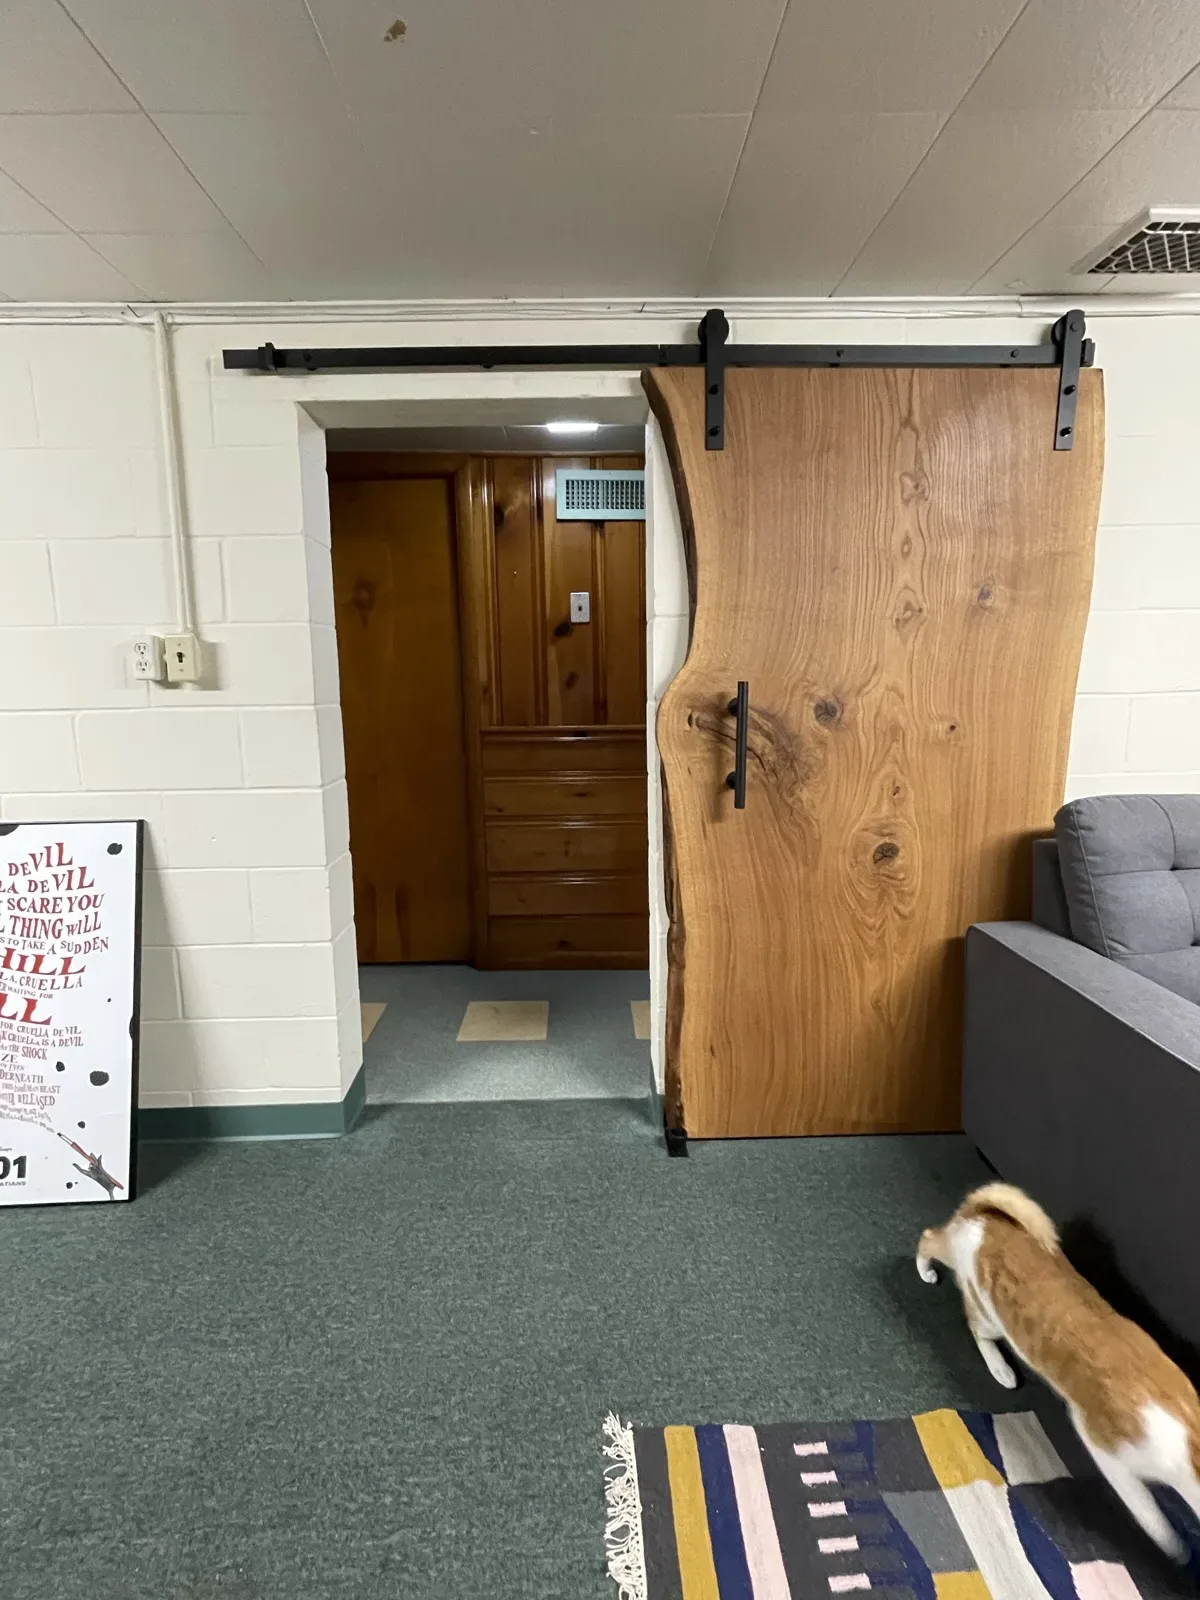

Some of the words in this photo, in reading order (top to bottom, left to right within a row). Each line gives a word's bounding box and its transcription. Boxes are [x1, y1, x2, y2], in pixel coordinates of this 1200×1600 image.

[7, 897, 63, 914] SCARE
[66, 893, 105, 913] YOU
[9, 914, 63, 940] THING
[66, 911, 102, 936] WILL
[7, 937, 20, 947] TO
[22, 939, 46, 951] TAKE
[47, 943, 57, 955] A
[60, 936, 109, 955] SUDDEN
[19, 975, 83, 991] CRUELLA
[7, 986, 37, 997] WAITING
[0, 1021, 13, 1030] FOR
[16, 1025, 49, 1038] CRUELLA
[42, 1038, 49, 1046] IS
[51, 1040, 56, 1048] A
[21, 1046, 48, 1060] SHOCK
